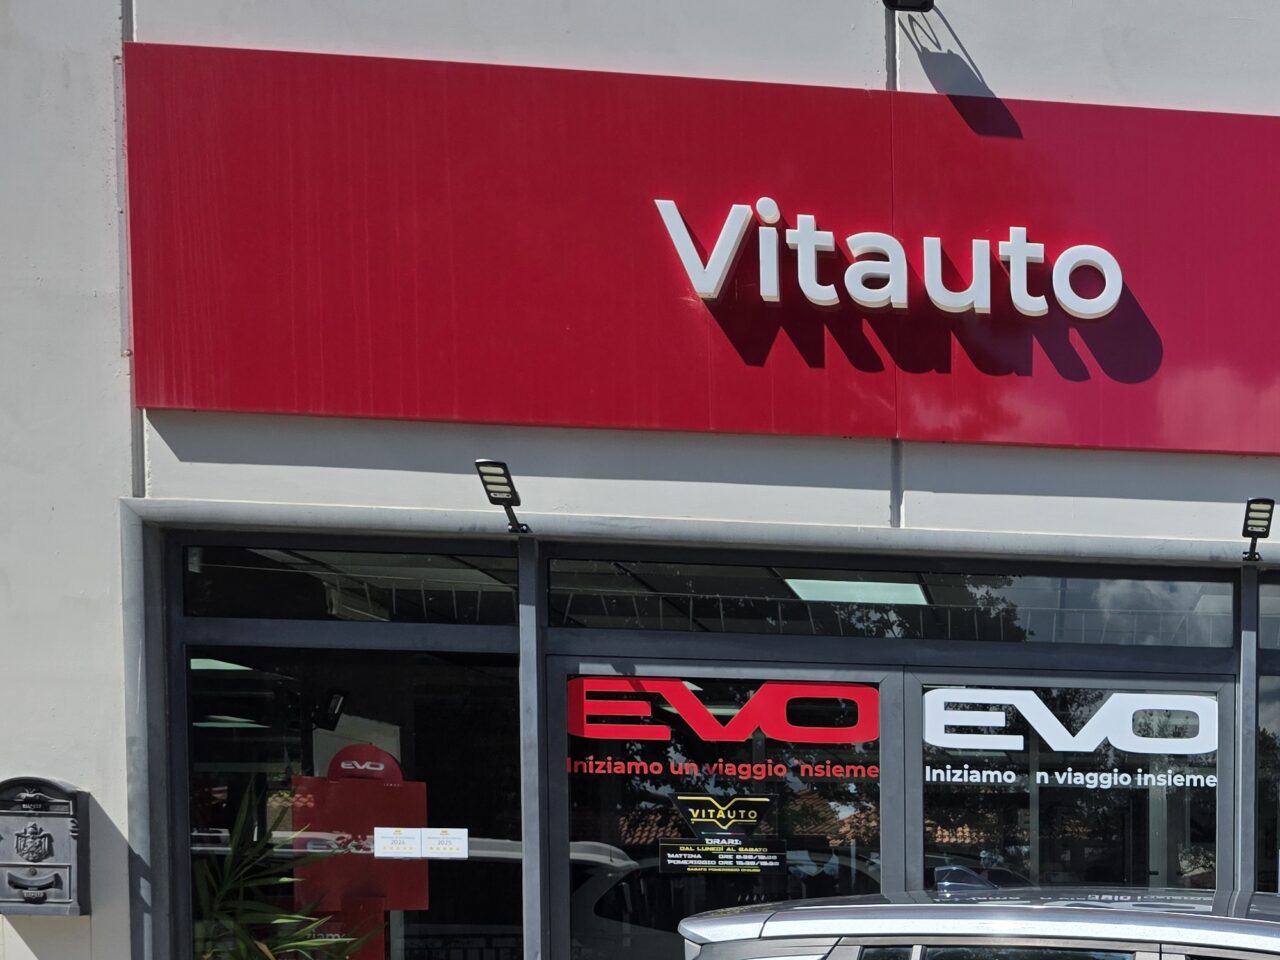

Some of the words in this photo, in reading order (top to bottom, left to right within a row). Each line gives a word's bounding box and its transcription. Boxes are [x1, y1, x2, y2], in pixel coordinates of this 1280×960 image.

[654, 196, 1123, 320] Vitauto
[567, 676, 880, 744] EVO
[922, 688, 1219, 755] EVO
[340, 760, 385, 771] EVO
[567, 754, 664, 775] Iniziamo
[670, 759, 698, 776] un
[706, 758, 788, 780] viaggio
[925, 764, 1017, 784] Iniziamo
[1054, 767, 1132, 789] viaggio
[1137, 768, 1218, 787] insieme
[688, 808, 758, 820] VITAUTO
